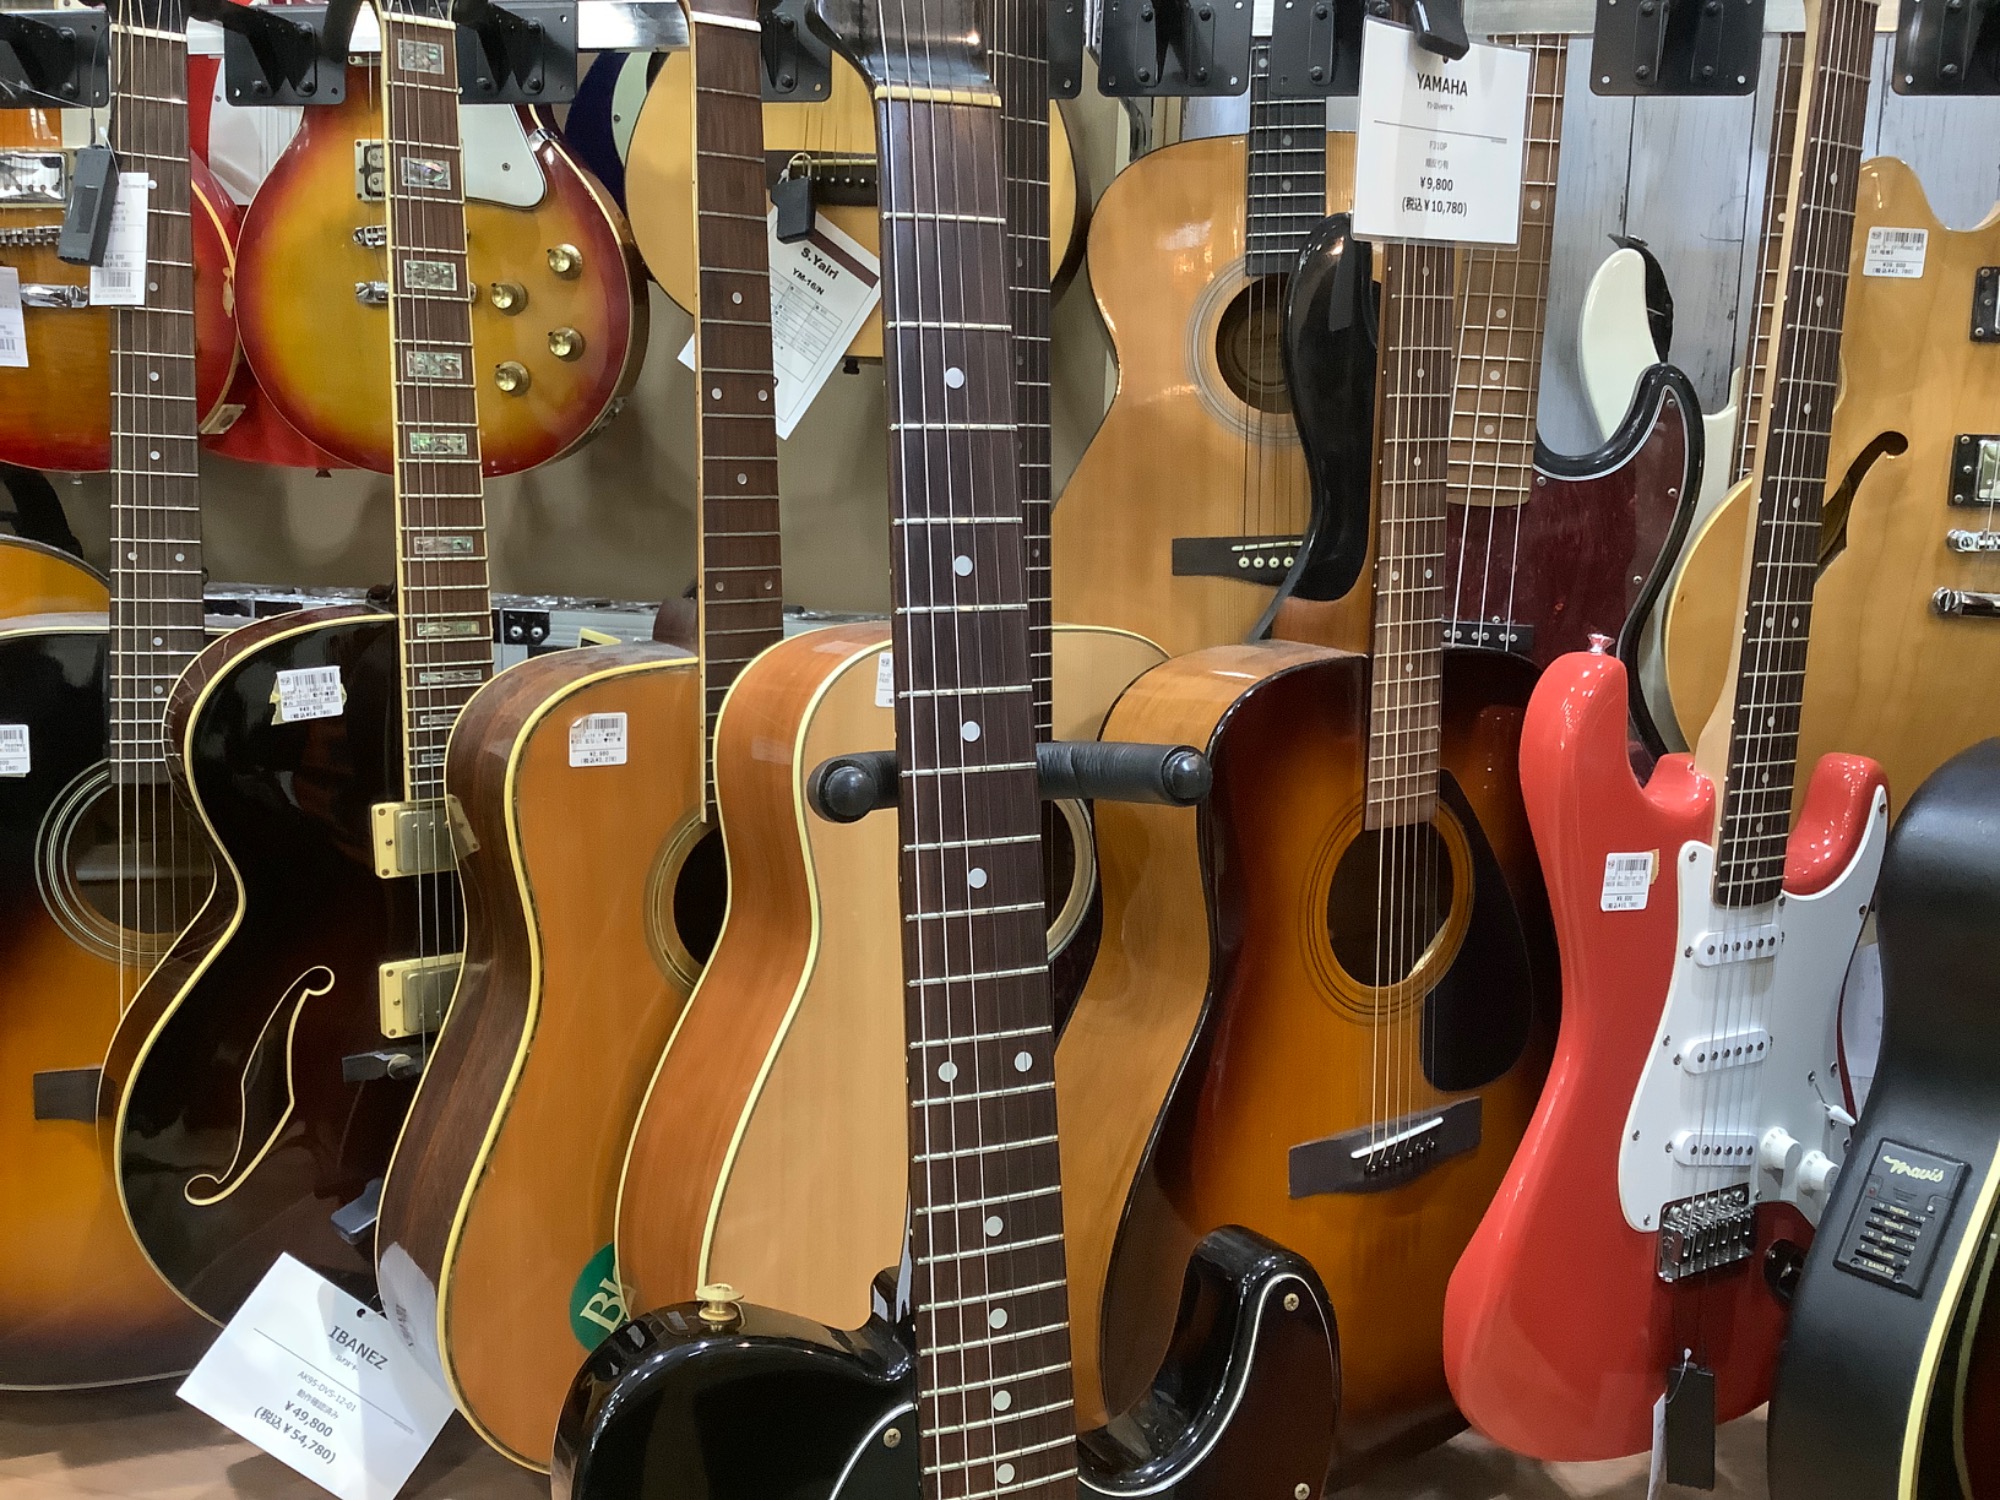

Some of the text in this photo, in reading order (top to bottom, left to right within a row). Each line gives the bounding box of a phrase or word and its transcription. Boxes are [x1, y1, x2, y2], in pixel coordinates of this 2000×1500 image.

[1417, 73, 1469, 97] YAMAHA
[1420, 177, 1453, 192] ¥9,800
[1402, 197, 1468, 217] (税込¥10,780)
[800, 247, 840, 280] S.Yairi
[328, 1325, 389, 1371] IBANEZ
[253, 1405, 337, 1465] (税込¥54,780)
[284, 1400, 334, 1438] ¥49,800
